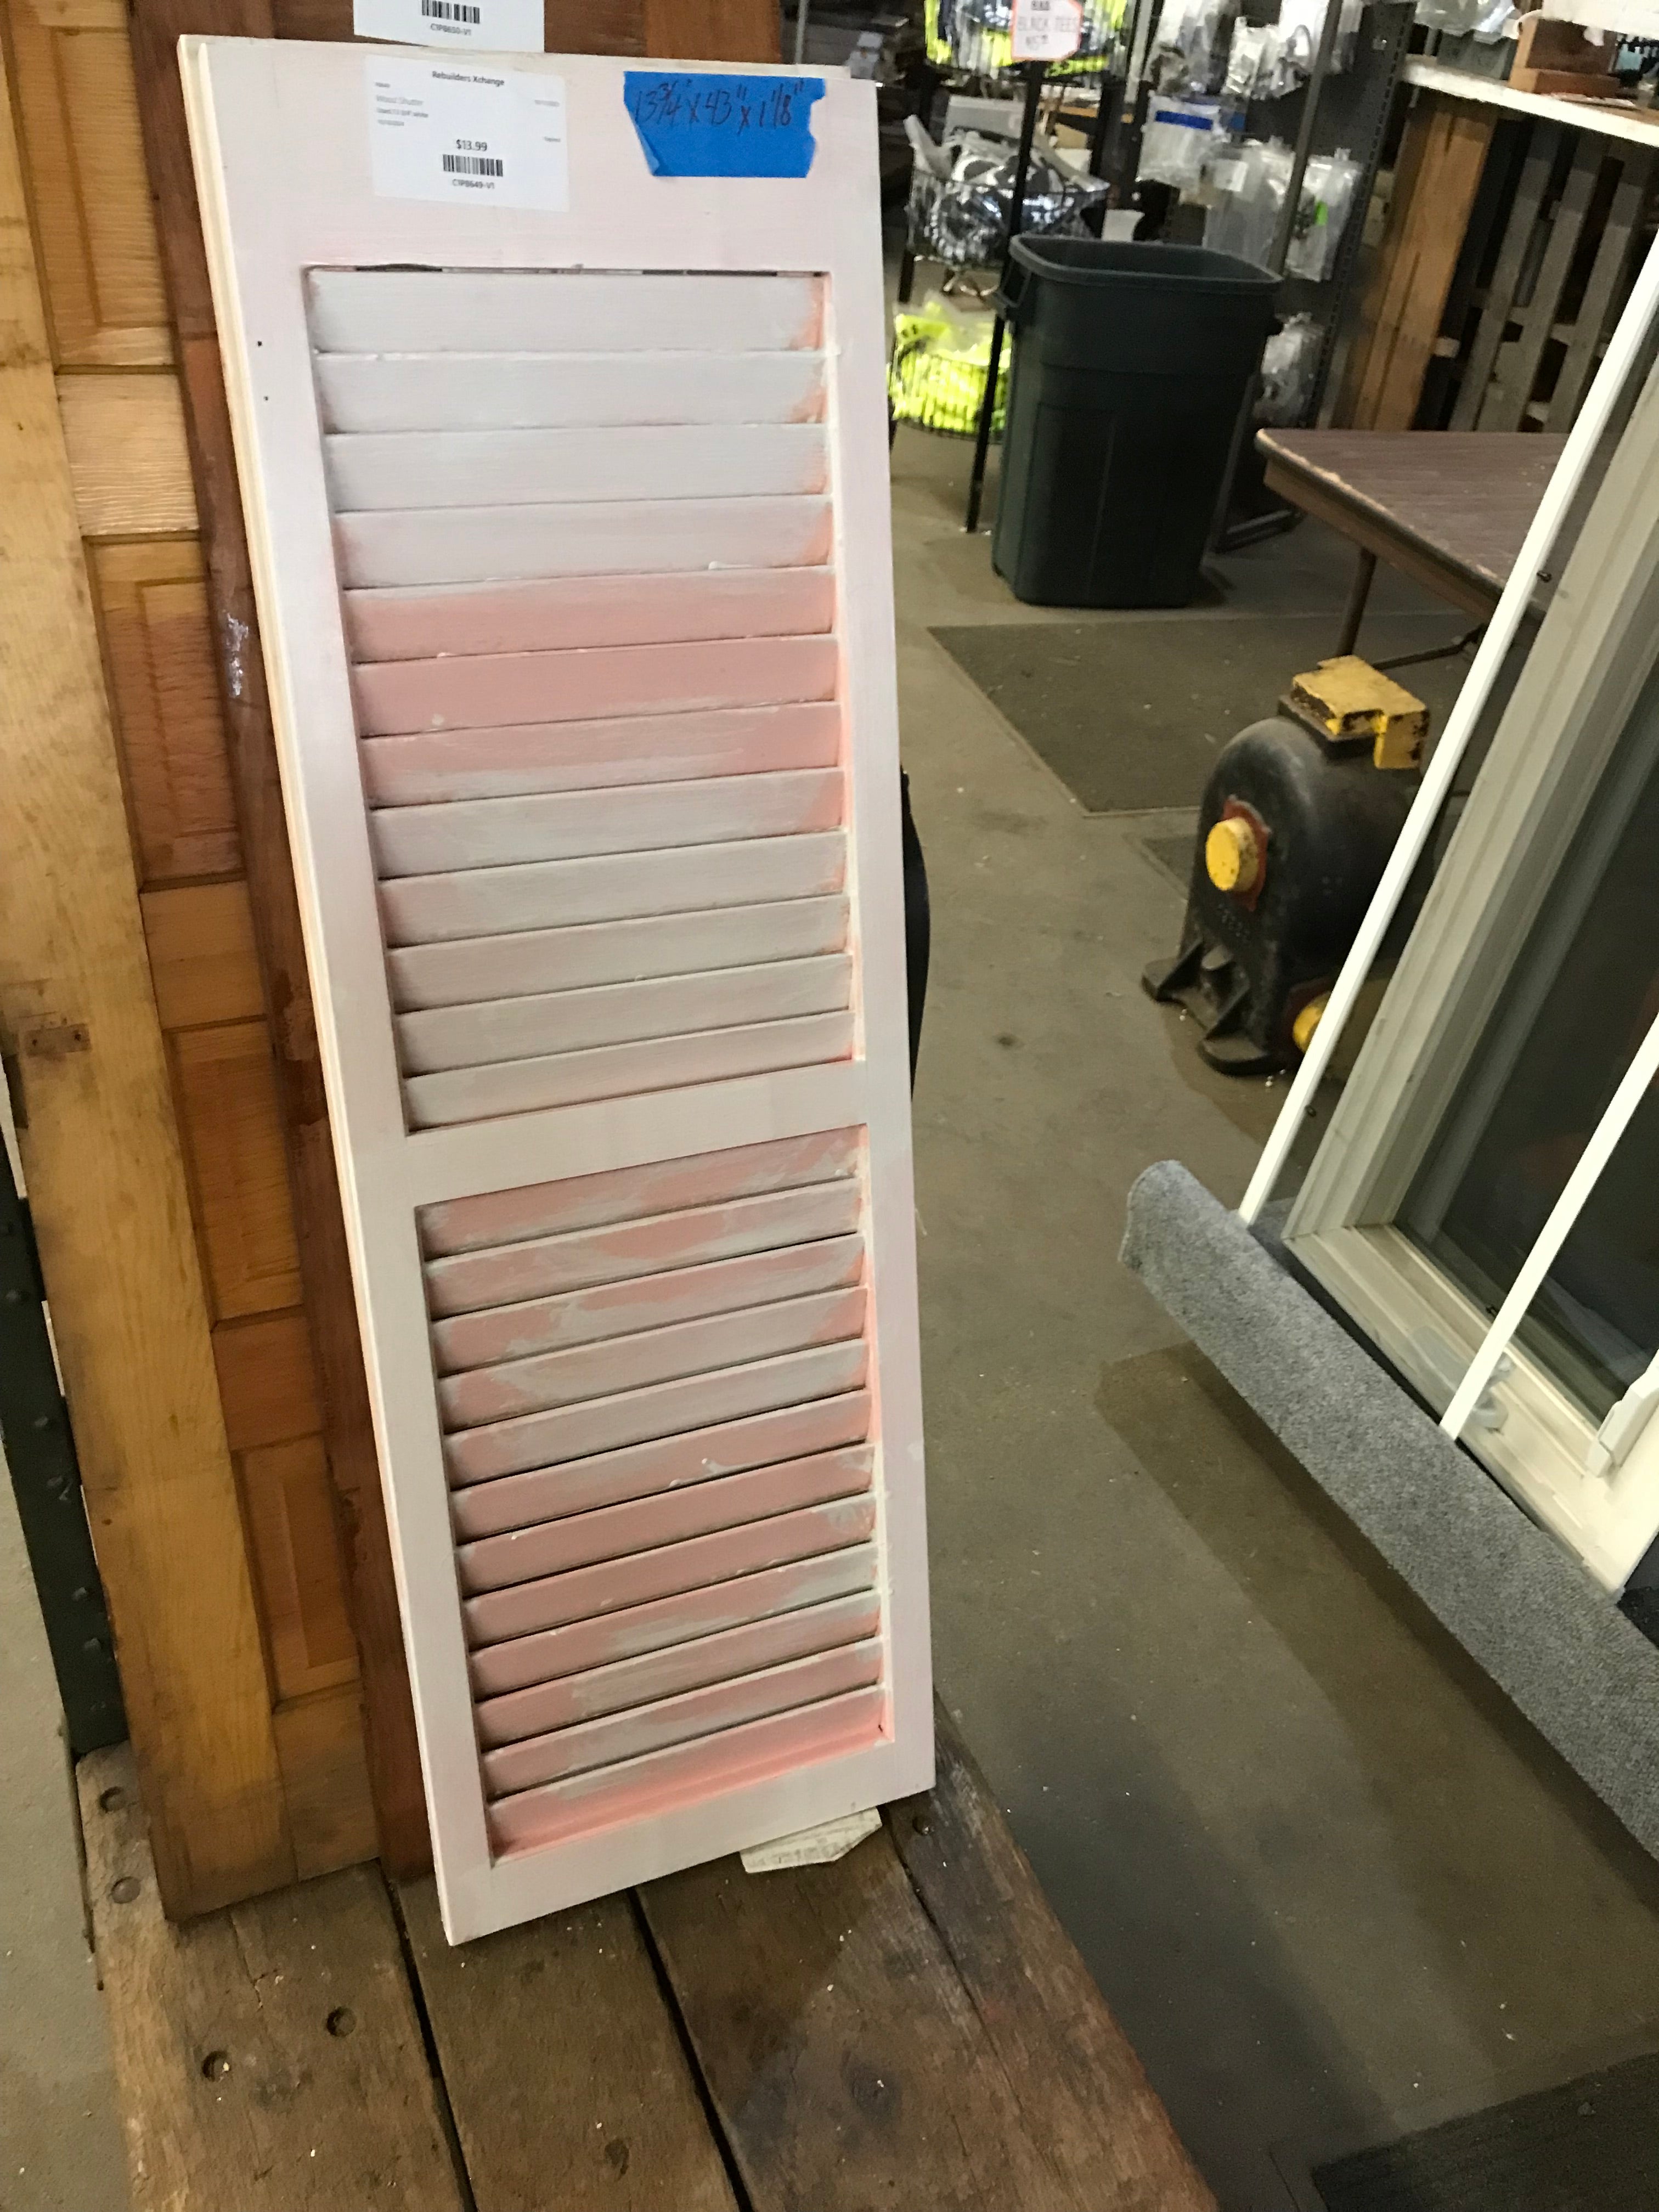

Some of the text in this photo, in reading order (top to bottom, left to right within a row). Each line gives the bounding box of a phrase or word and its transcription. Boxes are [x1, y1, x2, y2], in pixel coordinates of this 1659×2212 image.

[432, 71, 505, 87] Rebuilders Xchange
[456, 139, 487, 151] $13.99
